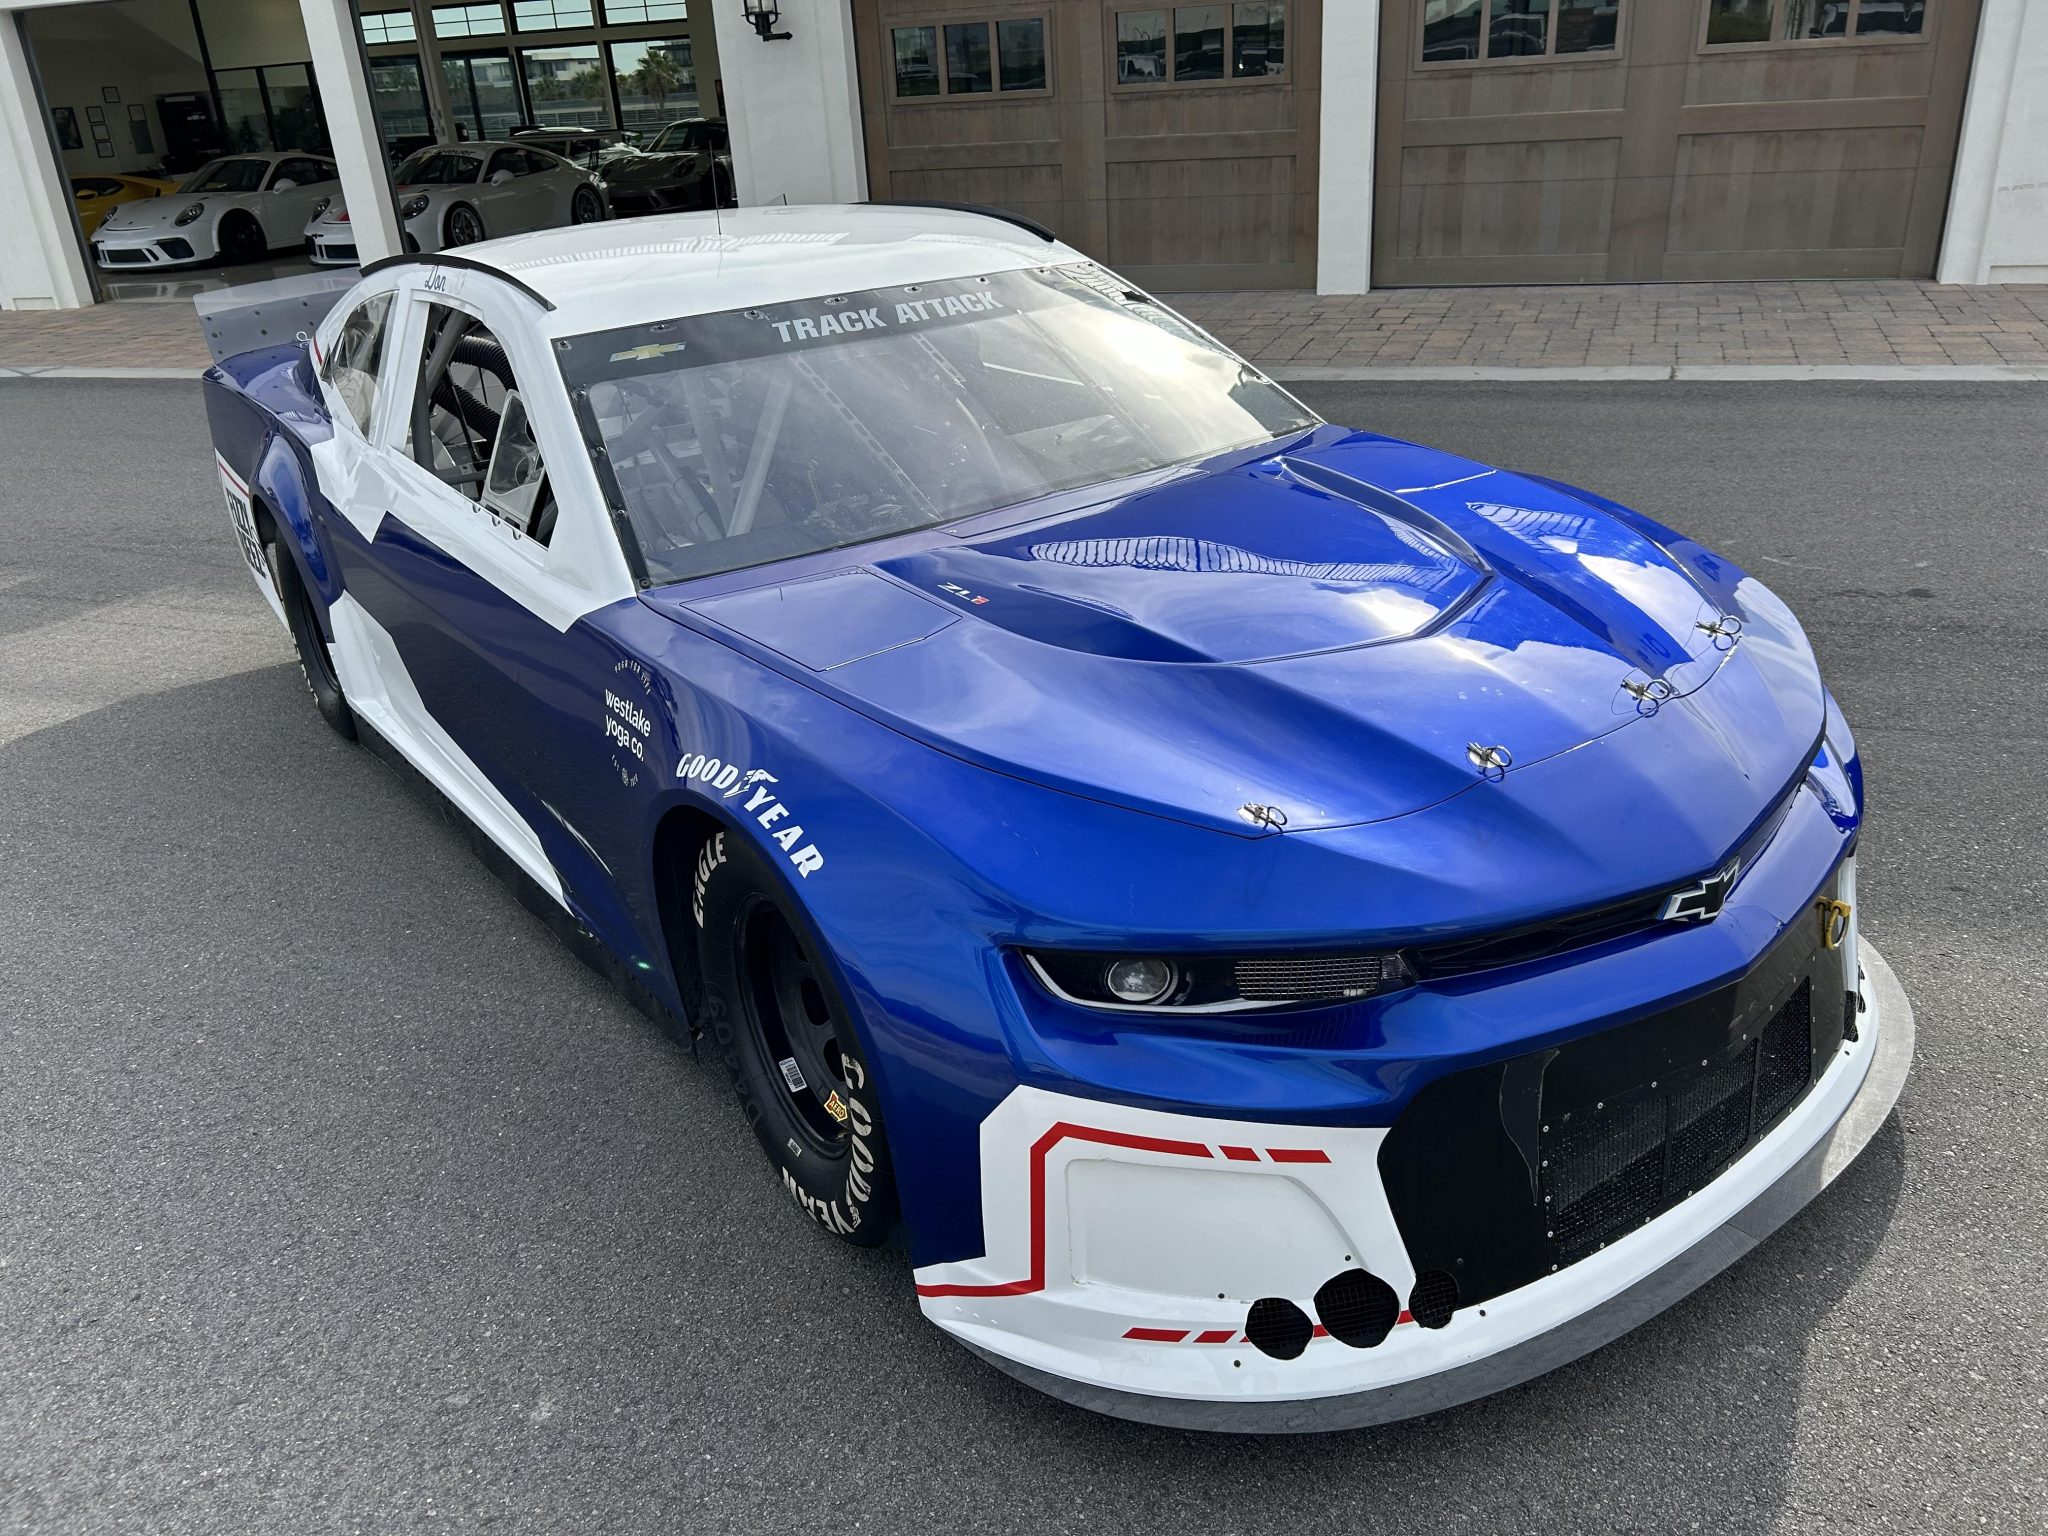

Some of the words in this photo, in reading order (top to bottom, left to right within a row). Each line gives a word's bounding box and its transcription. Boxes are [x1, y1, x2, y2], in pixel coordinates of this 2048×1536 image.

[425, 265, 446, 292] Don
[772, 307, 887, 343] TRACK
[895, 291, 1004, 324] ATTACK
[605, 688, 651, 737] westlake
[605, 714, 630, 747] yoga
[631, 736, 644, 762] co.
[675, 753, 824, 879] GOODYEAR
[692, 831, 727, 928] EAGLE
[829, 1100, 845, 1117] AERO
